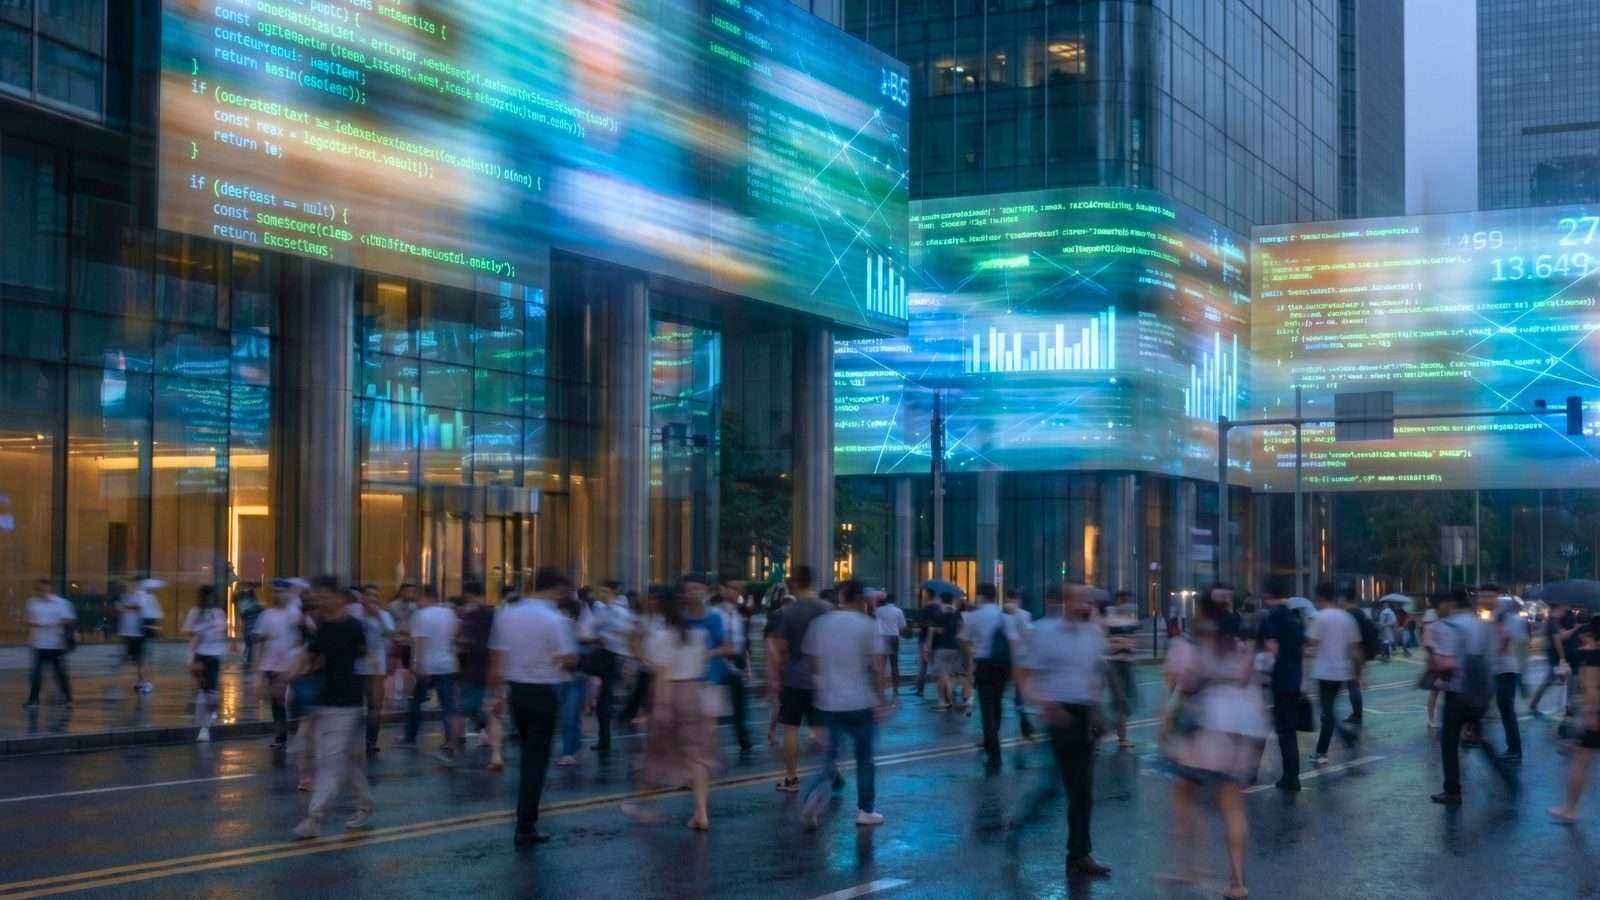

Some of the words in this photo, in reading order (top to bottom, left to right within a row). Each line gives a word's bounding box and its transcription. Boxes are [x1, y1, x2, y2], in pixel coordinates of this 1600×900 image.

[214, 6, 251, 28] const
[214, 47, 258, 71] return
[191, 79, 207, 96] if
[213, 110, 250, 128] const
[213, 130, 258, 151] return
[190, 175, 206, 190] if
[213, 203, 249, 221] const
[213, 223, 257, 244] return
